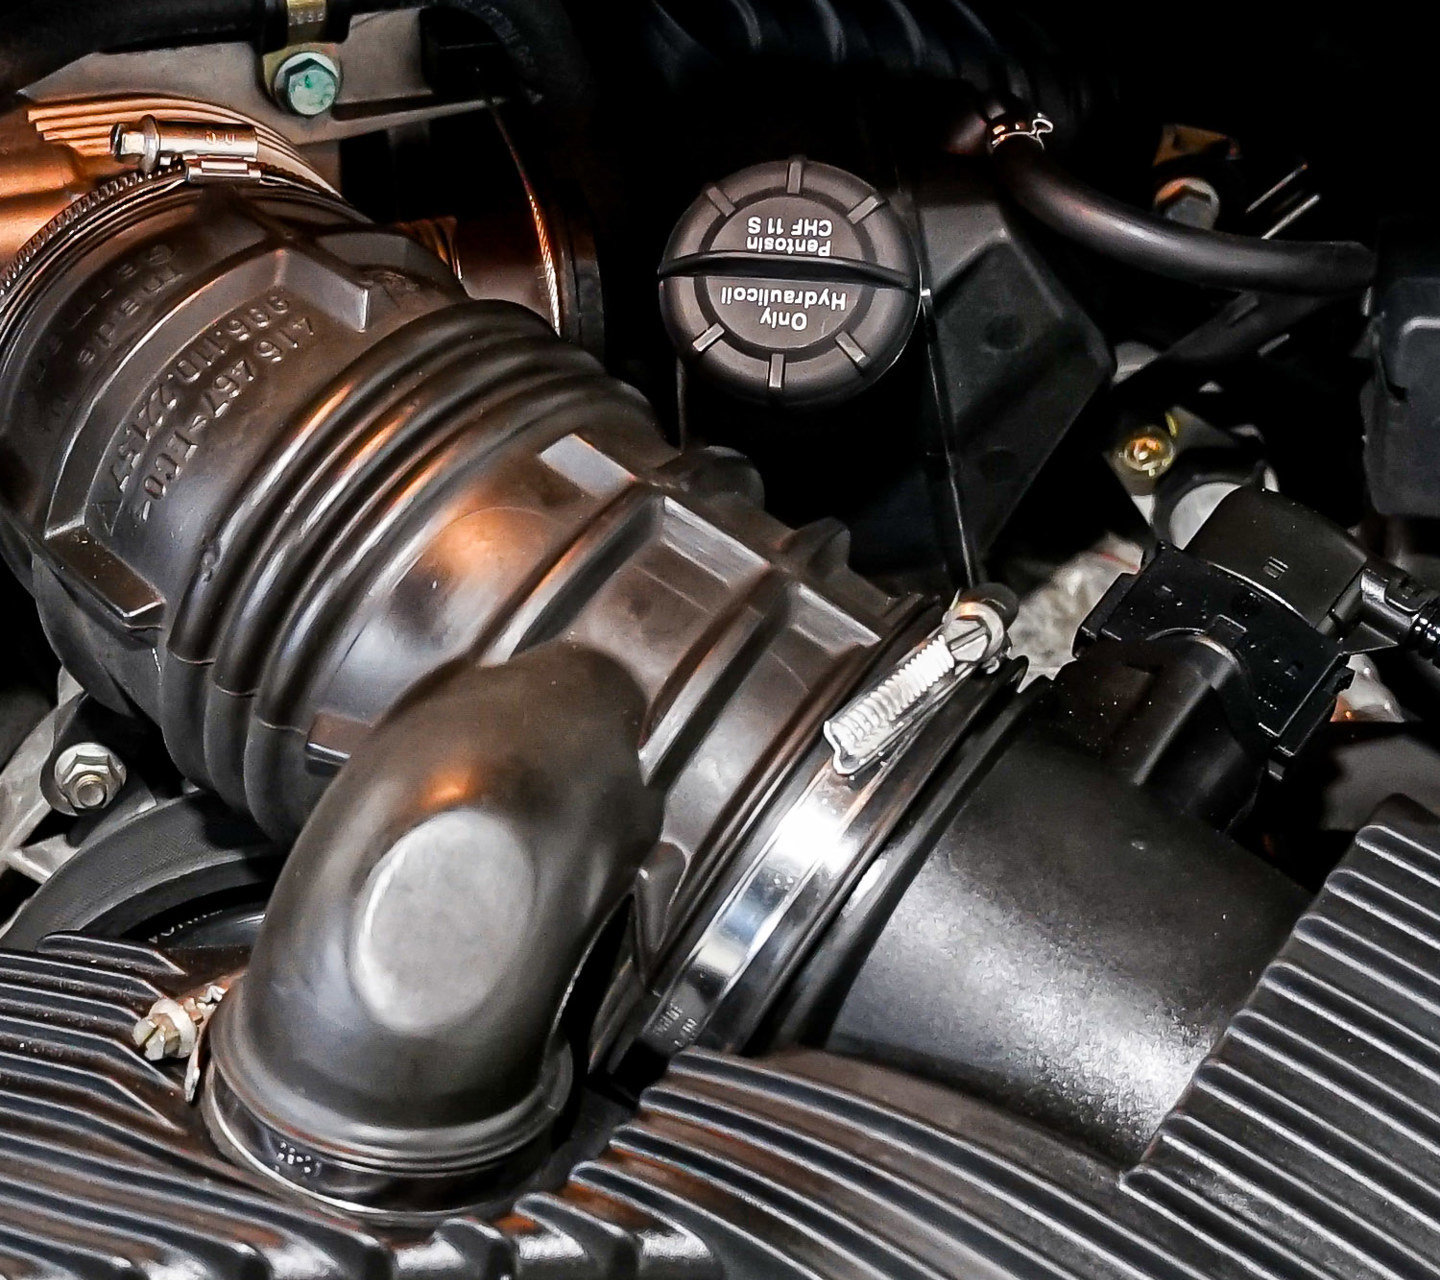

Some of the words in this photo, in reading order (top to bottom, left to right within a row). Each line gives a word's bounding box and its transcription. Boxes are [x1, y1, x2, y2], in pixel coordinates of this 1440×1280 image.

[746, 216, 762, 234] S
[766, 217, 784, 236] 11
[790, 218, 833, 237] CHF
[746, 236, 832, 257] Pentosin
[721, 286, 846, 311] Hydraulicoil
[759, 307, 808, 331] Only
